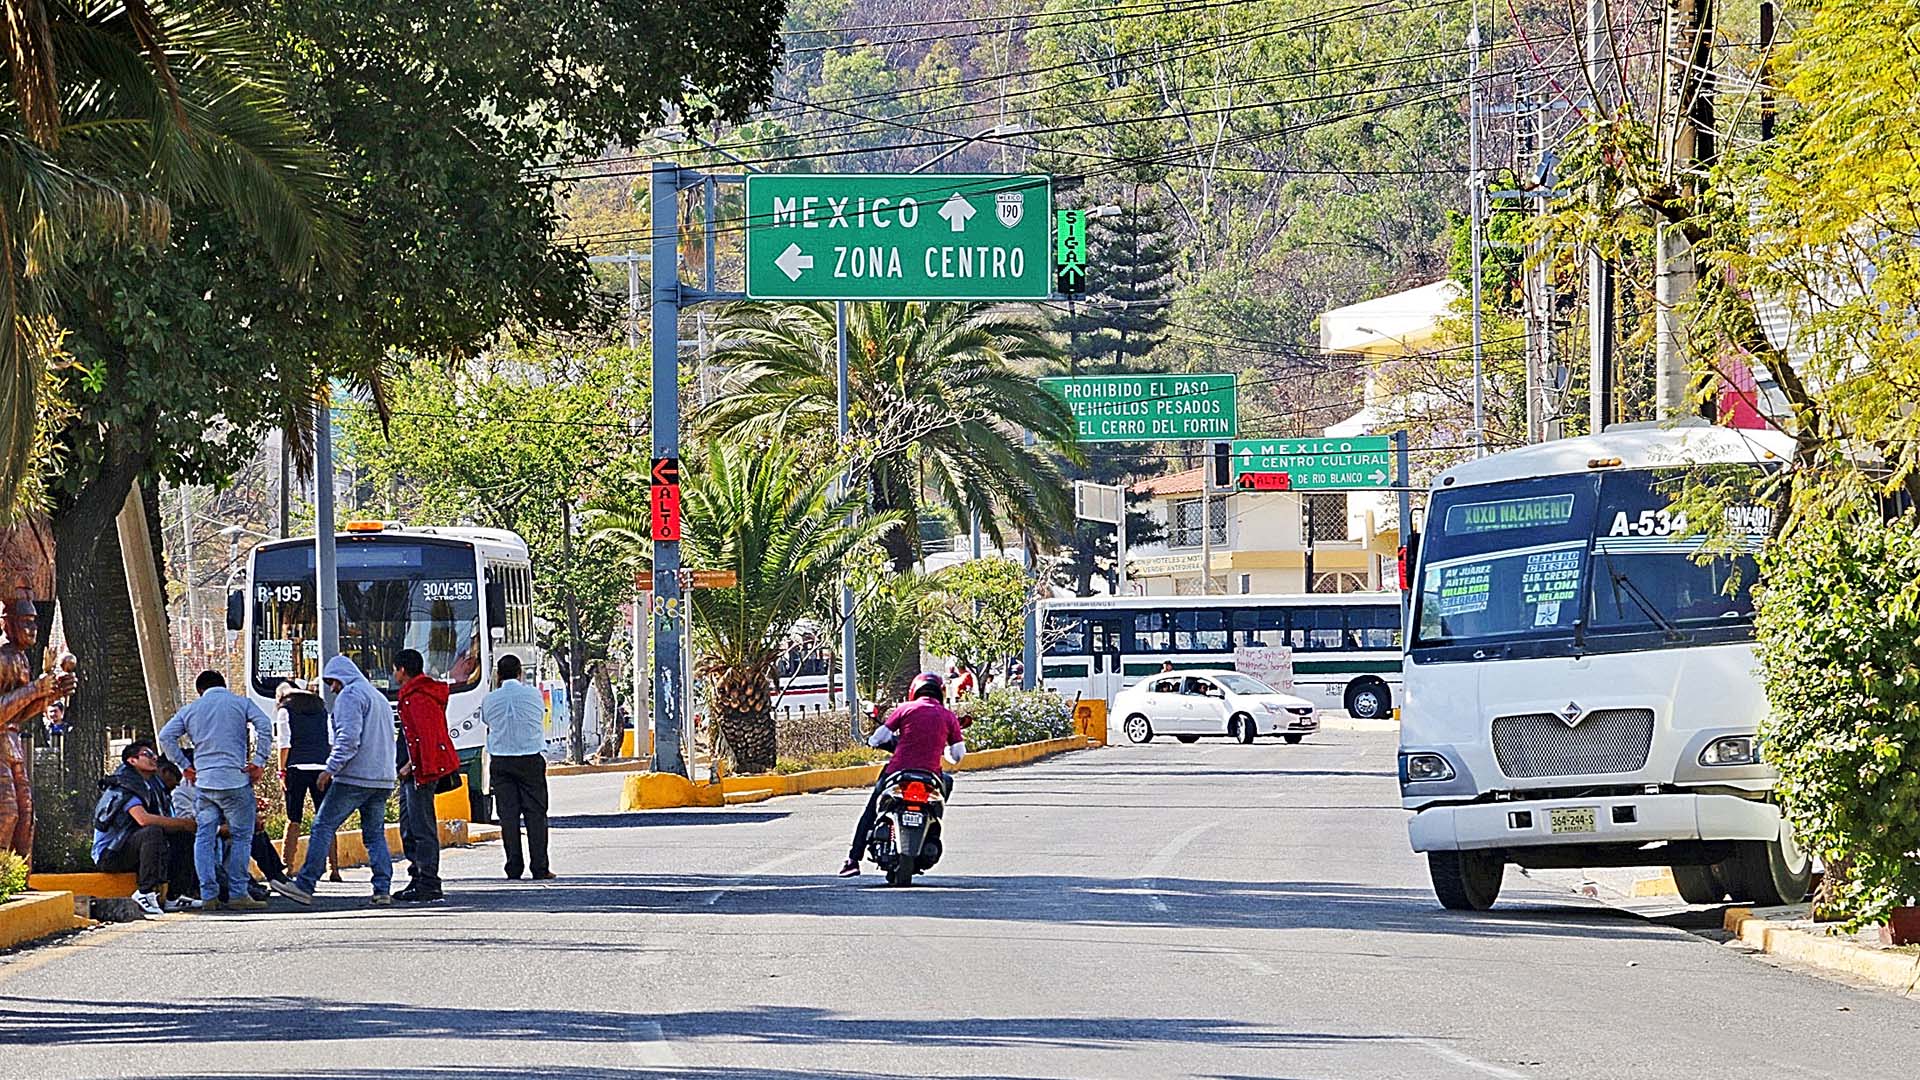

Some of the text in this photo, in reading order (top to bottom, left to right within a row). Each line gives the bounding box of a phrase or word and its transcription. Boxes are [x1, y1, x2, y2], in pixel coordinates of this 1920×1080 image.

[773, 196, 919, 228] MEXICO
[1002, 204, 1018, 219] 190
[1064, 211, 1079, 263] SIGA
[833, 246, 1025, 278] ZONA CENTRO
[1064, 381, 1209, 399] PROHIBIDO EL PASO
[1069, 400, 1220, 416] VEHICULOS PESADOS
[1079, 418, 1229, 435] EL CERRO DEL FORTIN
[1261, 442, 1352, 455] MEXICO
[1262, 454, 1388, 468] CENTRO CULTURAL
[1256, 476, 1285, 485] ALTO
[1297, 475, 1308, 484] DE
[1312, 474, 1326, 483] RIO
[1330, 473, 1362, 482] BLANCO
[659, 487, 672, 537] ALTO
[1464, 505, 1496, 524] XOXO
[1609, 510, 1688, 537] A-534
[1528, 551, 1580, 564] CENTRO
[1445, 569, 1458, 578] AV
[1526, 560, 1579, 573] CRESPO
[1445, 575, 1490, 588] ARTEAGA
[1543, 570, 1579, 581] CRESPO
[423, 582, 473, 596] 30/V-150
[1523, 580, 1577, 593] LA LOMA
[1551, 814, 1594, 827] 364-244-S
